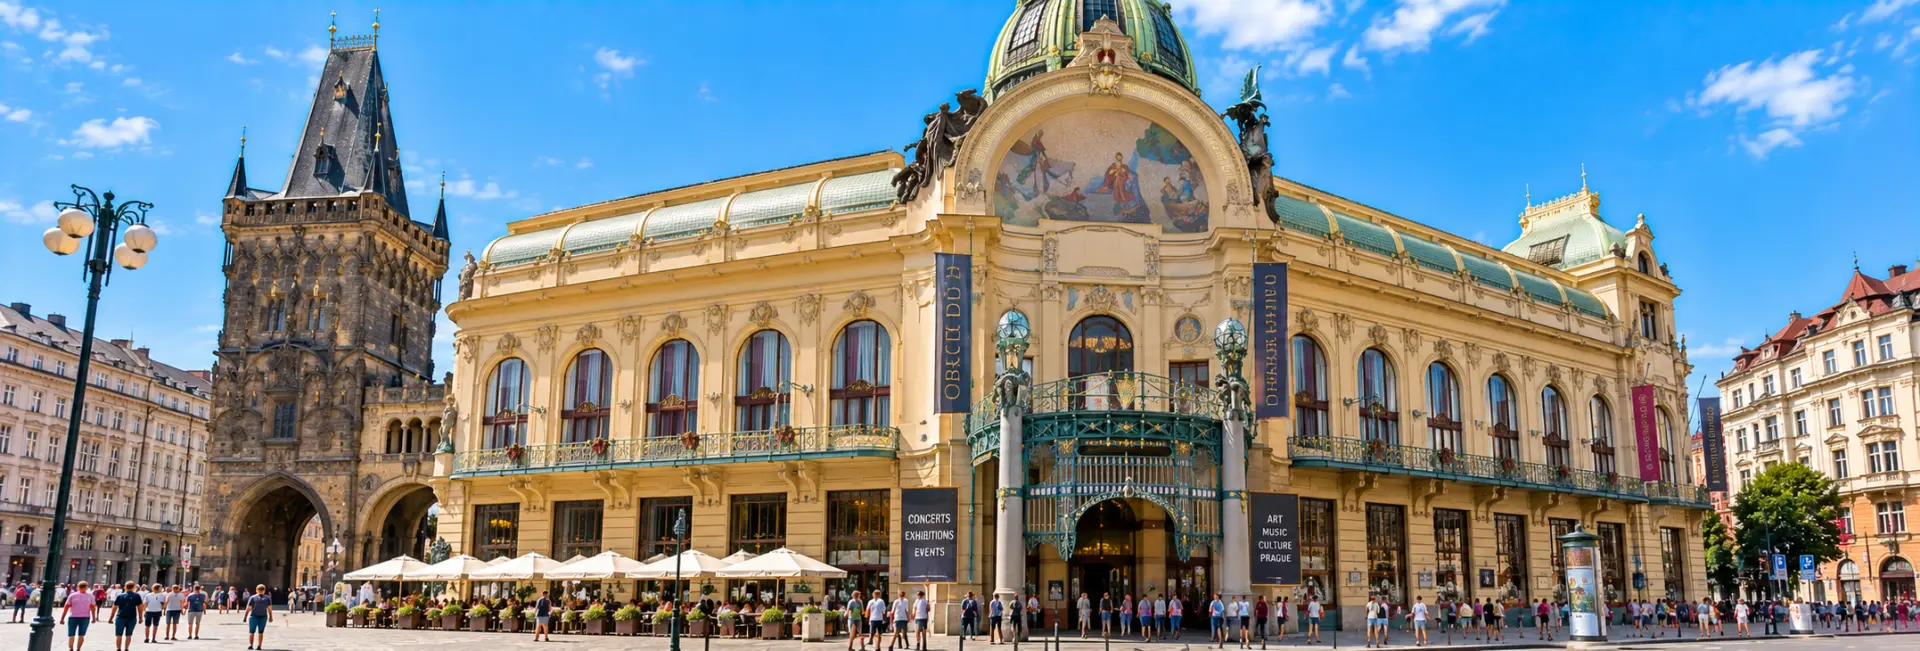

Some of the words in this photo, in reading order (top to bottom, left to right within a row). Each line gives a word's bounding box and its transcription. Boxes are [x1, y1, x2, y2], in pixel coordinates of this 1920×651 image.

[908, 513, 951, 524] CONCERTS
[1267, 514, 1284, 524] ART
[905, 530, 954, 541] EXHIBITIONS
[1262, 527, 1288, 537] MUSIC
[1258, 540, 1292, 550] CULTURE
[914, 547, 945, 557] EVENTS
[1260, 553, 1292, 563] PRAGUE
